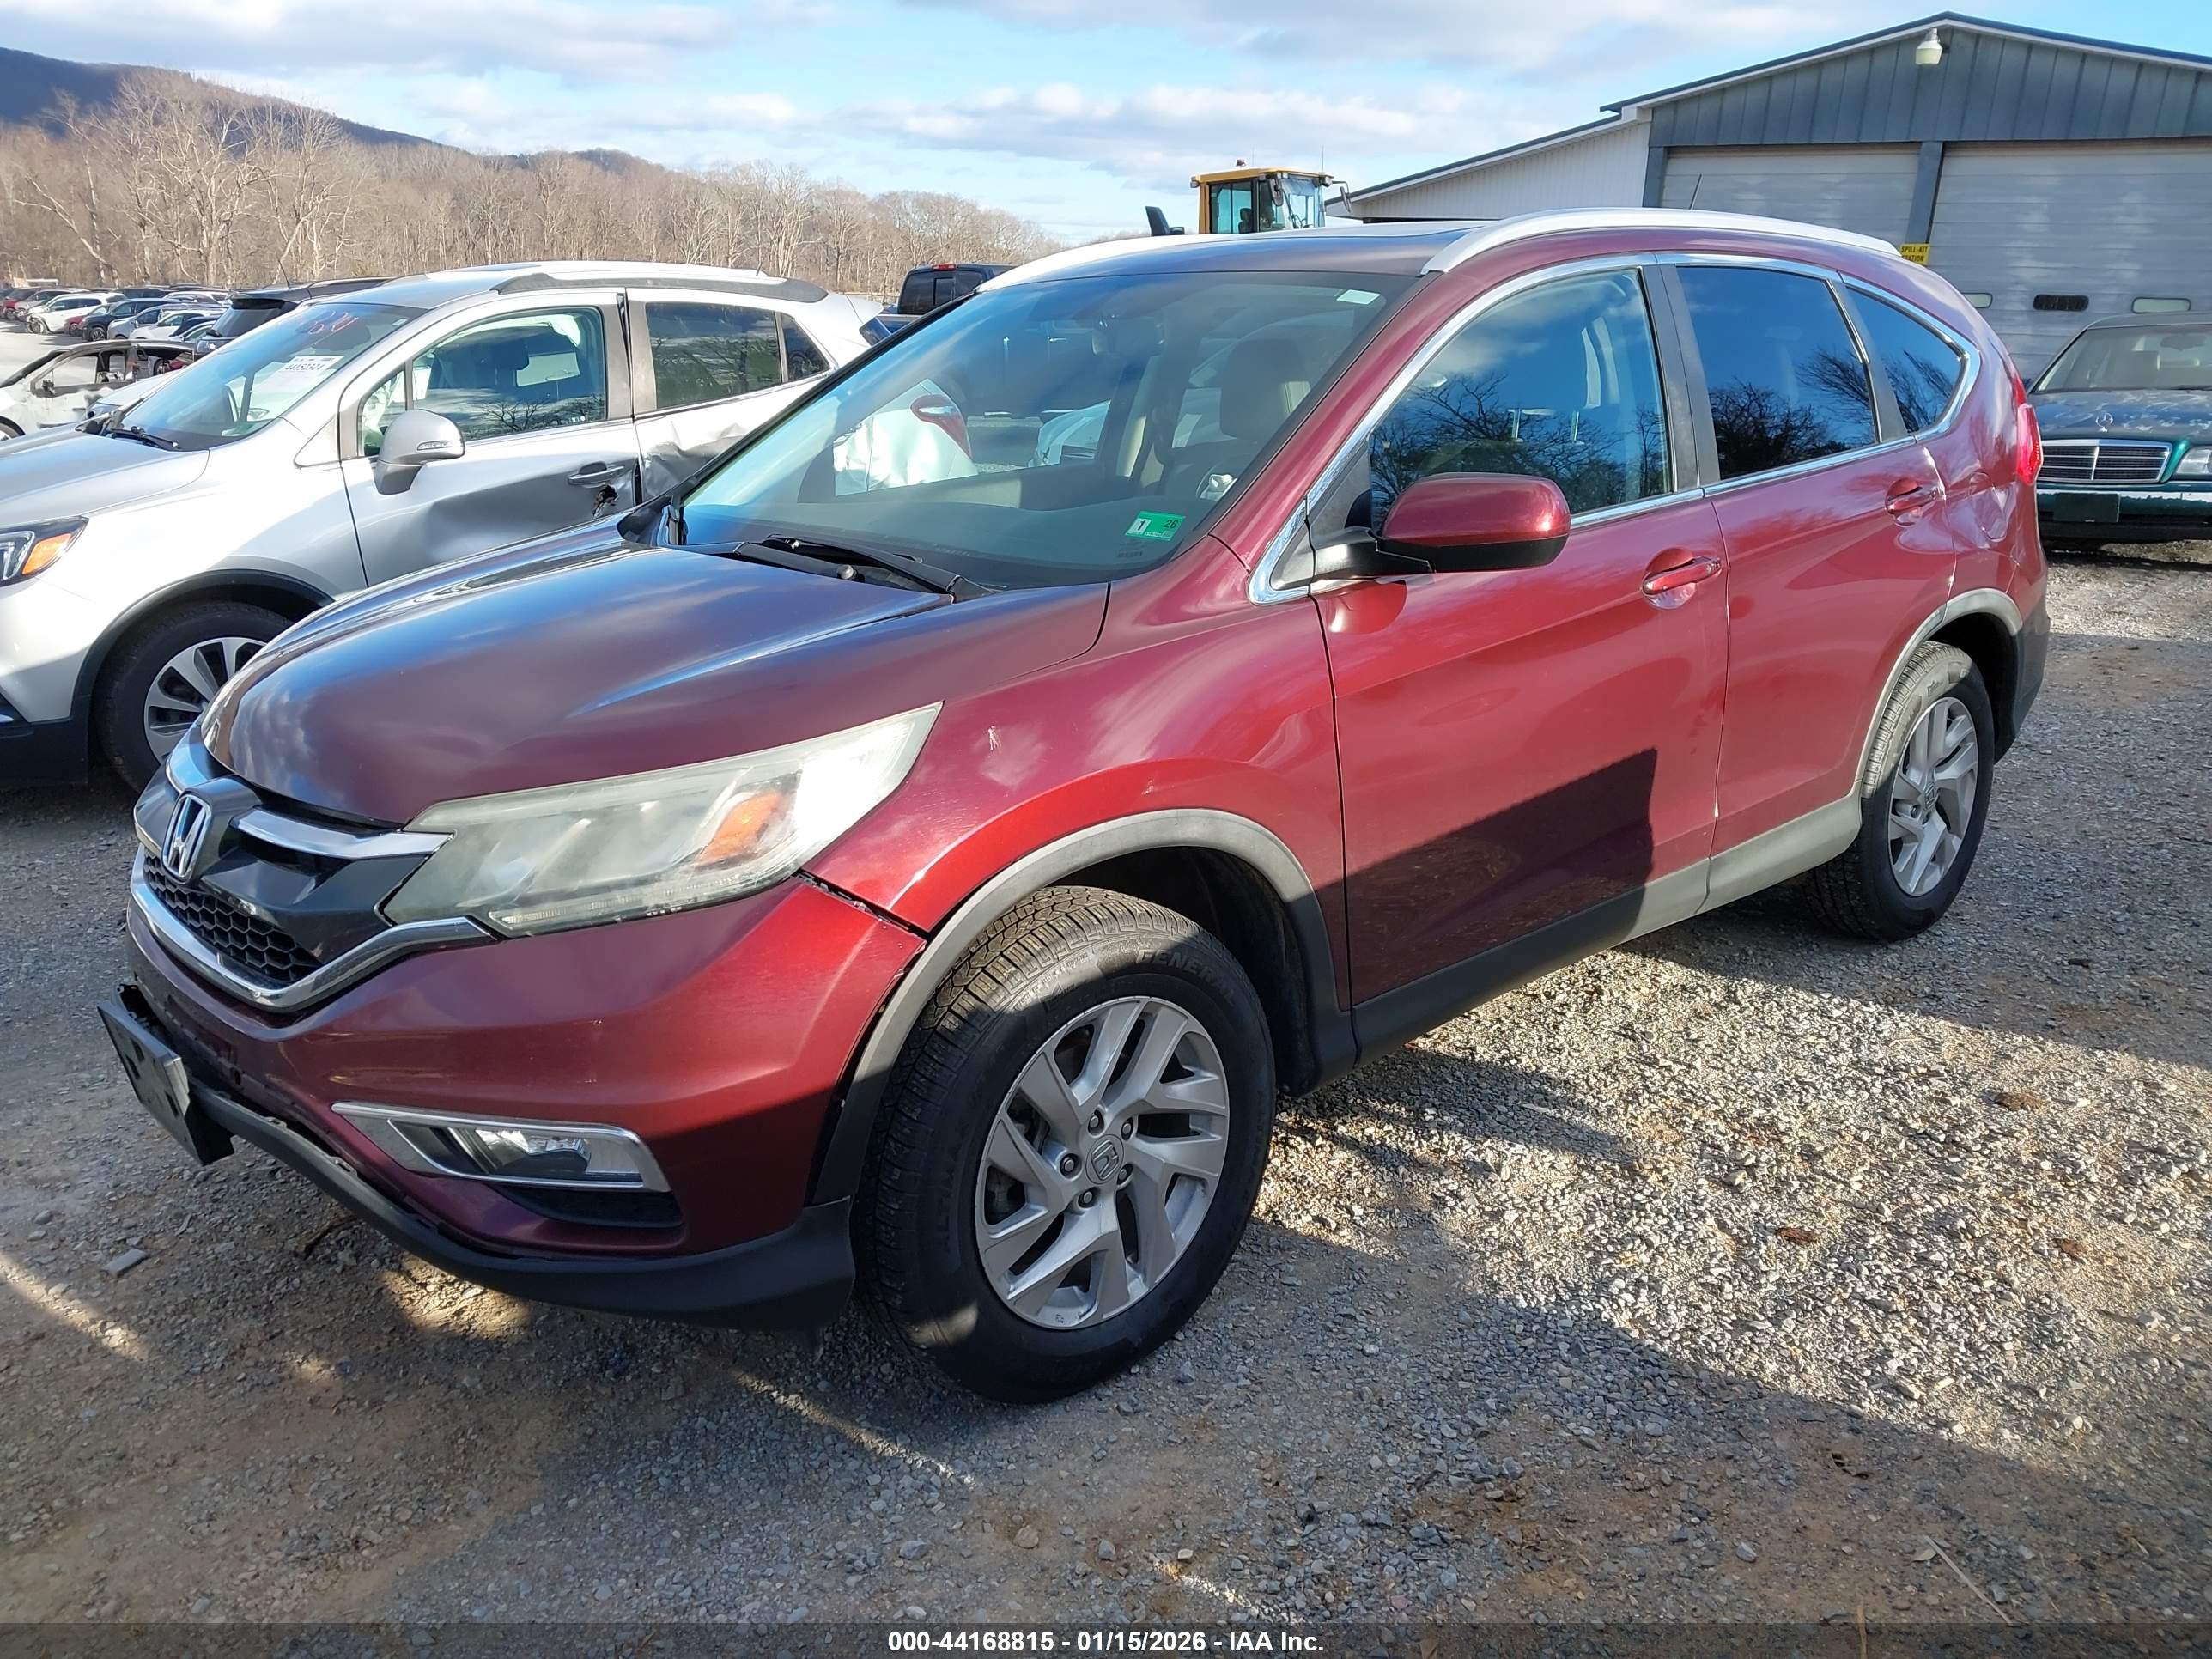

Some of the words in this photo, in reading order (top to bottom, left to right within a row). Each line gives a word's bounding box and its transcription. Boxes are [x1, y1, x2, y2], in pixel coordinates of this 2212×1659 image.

[1137, 520, 1146, 531] 1
[1164, 519, 1179, 529] 26
[1136, 948, 1236, 1005] GENERAL
